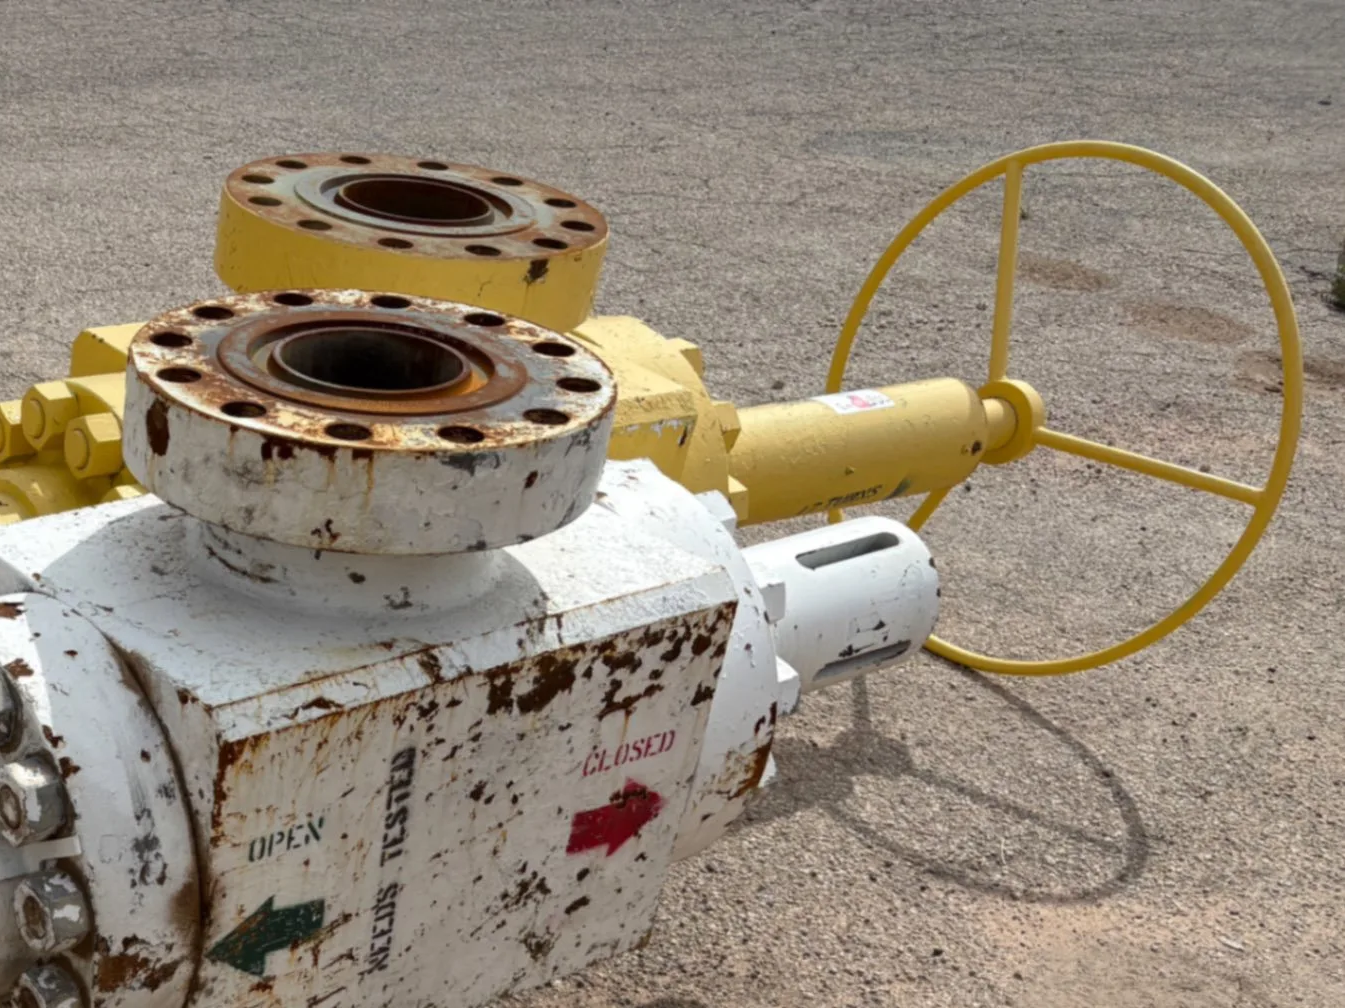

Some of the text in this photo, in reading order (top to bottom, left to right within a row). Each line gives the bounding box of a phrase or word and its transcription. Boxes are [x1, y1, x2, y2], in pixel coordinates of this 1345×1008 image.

[583, 730, 675, 776] CLOSED
[248, 816, 324, 862] OPEN
[365, 747, 416, 974] NEEDS TESTED
